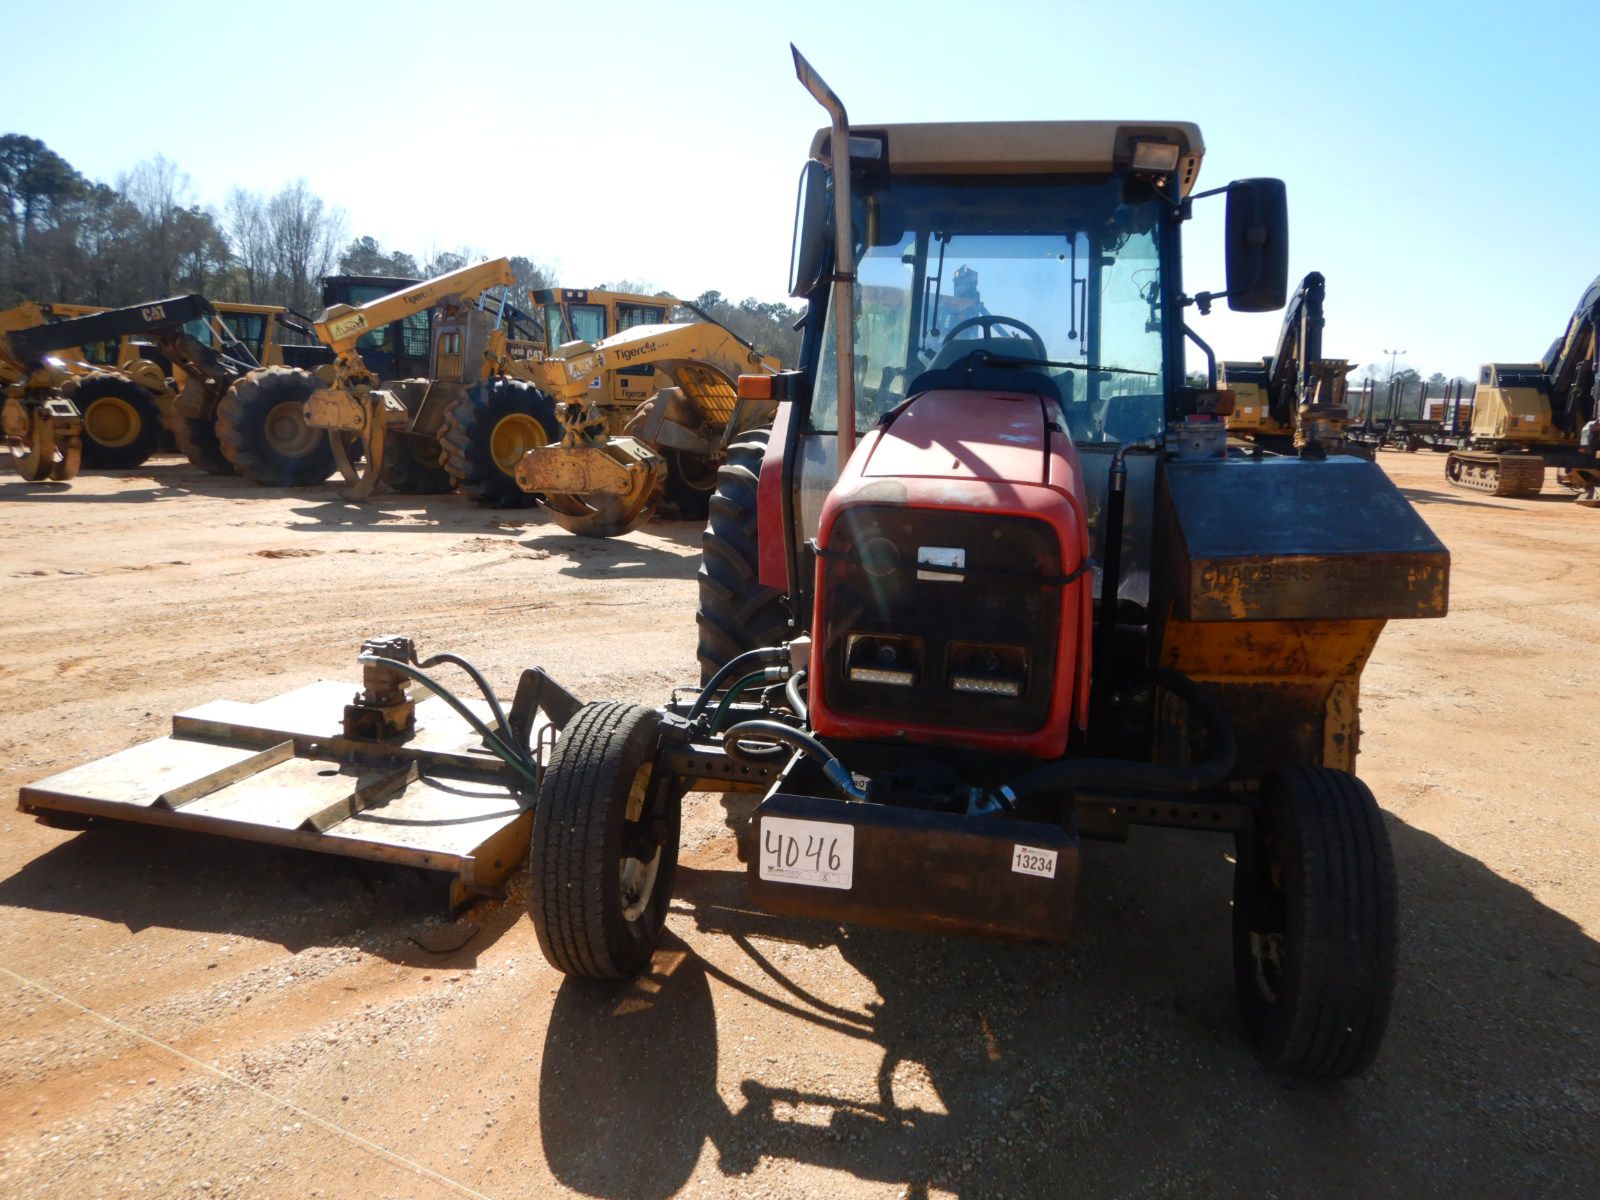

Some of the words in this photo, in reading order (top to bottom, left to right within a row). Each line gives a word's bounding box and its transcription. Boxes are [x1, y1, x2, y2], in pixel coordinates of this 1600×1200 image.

[402, 287, 433, 304] Tigerc
[143, 305, 166, 321] CAT
[526, 349, 542, 362] CAT
[614, 342, 656, 360] Tigercat
[622, 390, 647, 398] Tigercat
[765, 829, 841, 871] 4046
[1016, 853, 1053, 873] 13234
